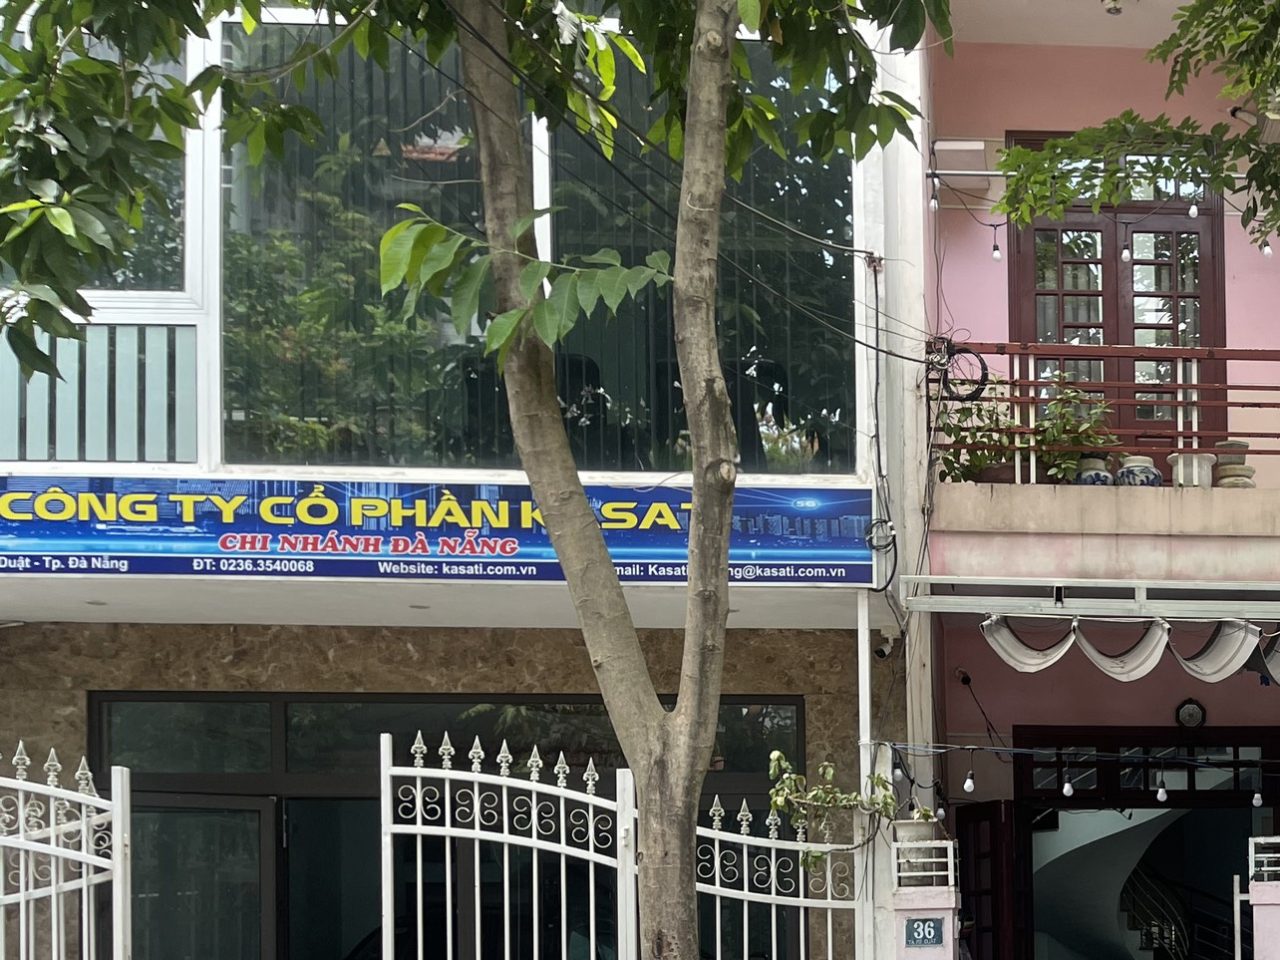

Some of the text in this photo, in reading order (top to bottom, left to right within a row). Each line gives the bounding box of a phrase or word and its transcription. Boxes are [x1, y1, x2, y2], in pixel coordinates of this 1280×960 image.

[0, 487, 158, 522] CÔNG
[169, 495, 248, 523] TY
[259, 484, 339, 525] CỔ
[351, 489, 509, 528] PHẦN
[219, 529, 519, 556] CHI NHÁNH ĐÀ NẴNG
[43, 557, 65, 571] Tp.
[68, 557, 87, 569] Đà
[91, 555, 129, 572] Nẵng
[193, 558, 315, 572] ĐT: 0236.3540068
[378, 562, 537, 576] Website: kasati.com.vn
[614, 564, 645, 576] mail:
[913, 921, 935, 939] 36
